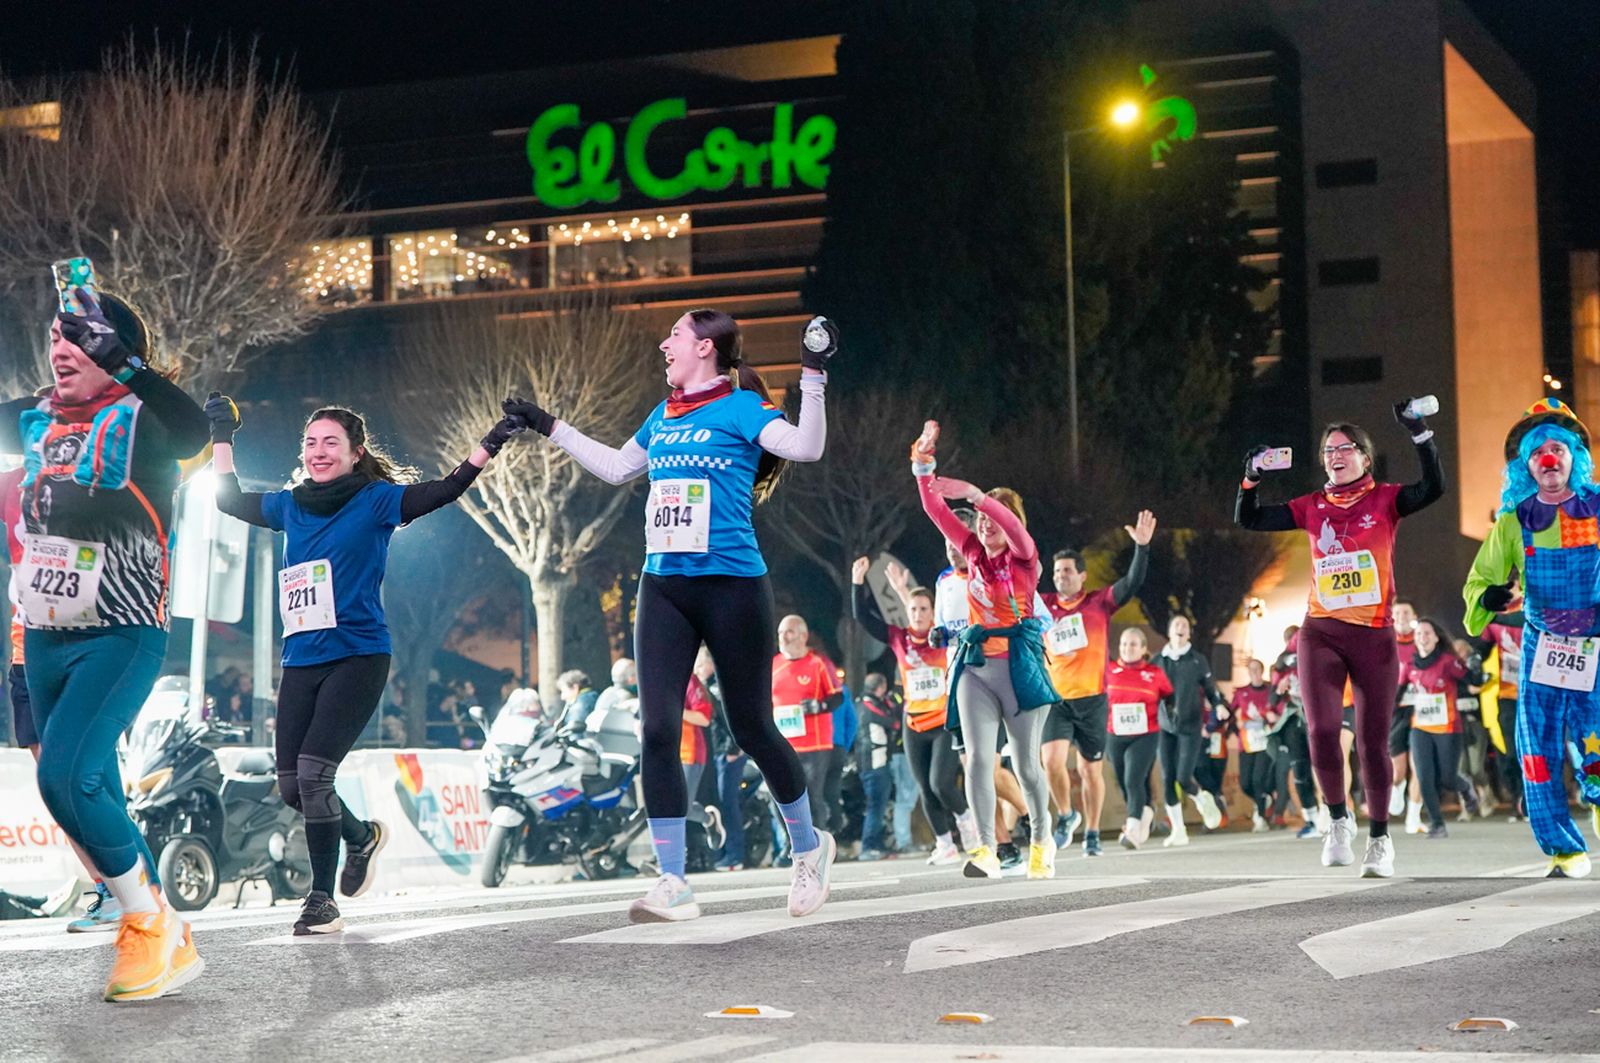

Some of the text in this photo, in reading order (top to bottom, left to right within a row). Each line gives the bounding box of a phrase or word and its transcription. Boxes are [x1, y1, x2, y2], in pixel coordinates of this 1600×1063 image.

[526, 97, 838, 209] El Corte
[650, 428, 712, 447] POLO
[654, 505, 693, 528] 6014
[30, 567, 80, 598] 4223
[1331, 571, 1362, 591] 230
[288, 586, 317, 611] 2211
[1546, 650, 1586, 672] 6245
[442, 784, 481, 815] SAN
